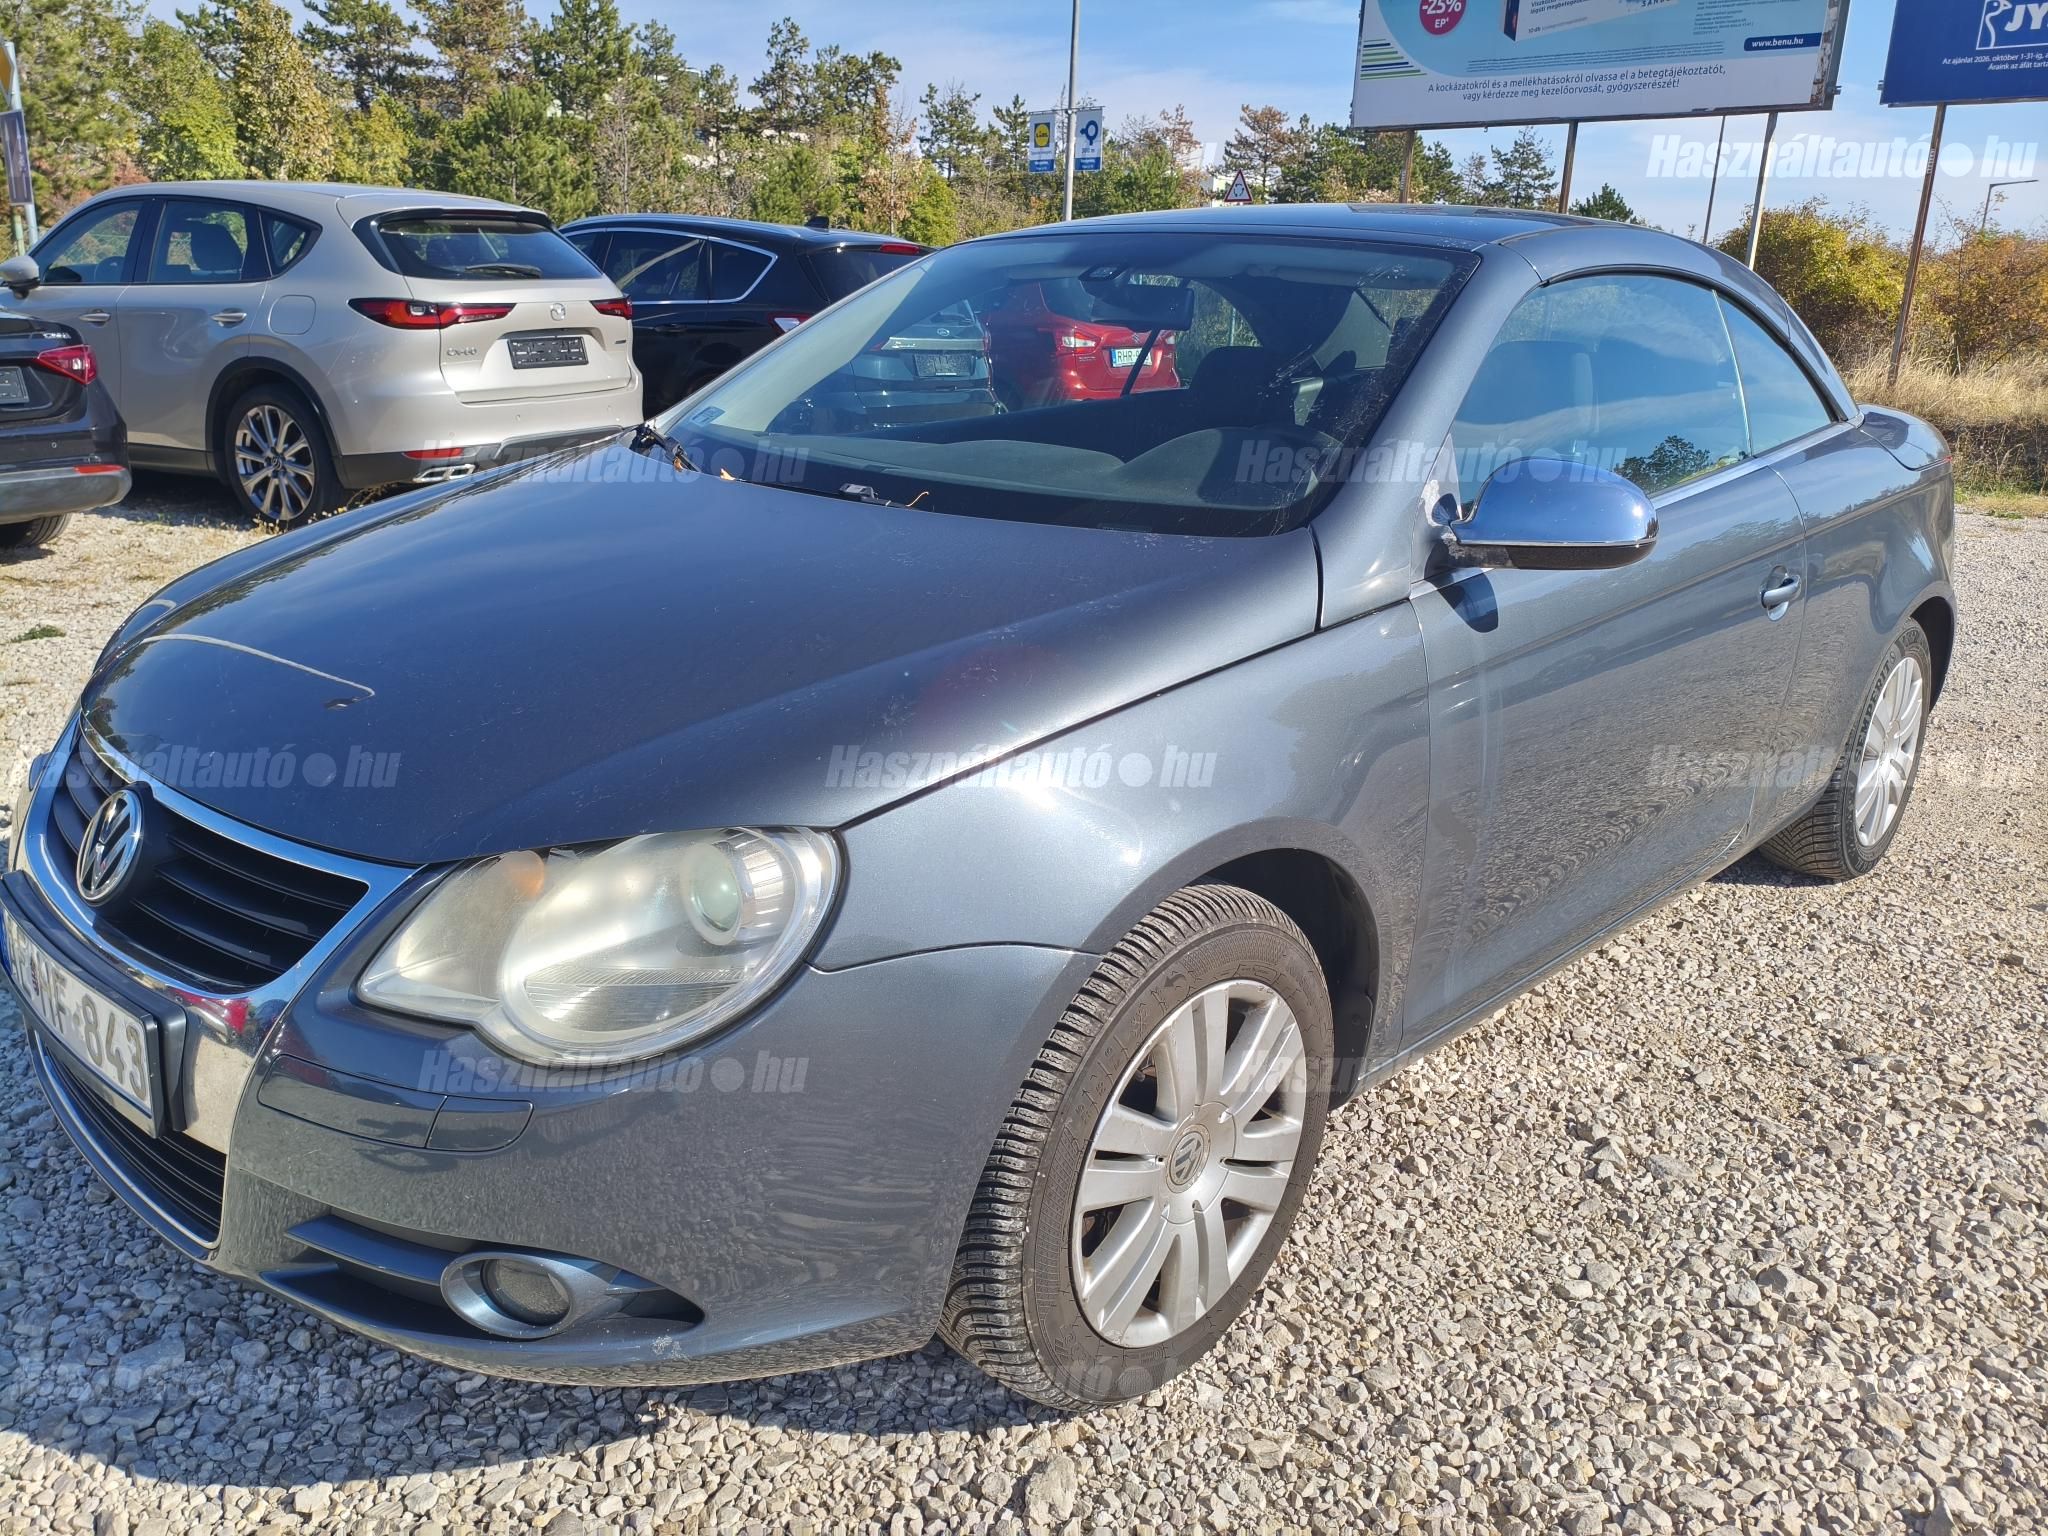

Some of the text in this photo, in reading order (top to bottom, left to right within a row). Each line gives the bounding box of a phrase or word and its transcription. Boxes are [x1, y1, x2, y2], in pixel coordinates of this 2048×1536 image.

[2004, 2, 2048, 32] JY
[1751, 37, 1805, 48] www.benu.hu
[1428, 84, 1434, 93] A
[1436, 80, 1490, 92] kockázatokról
[1492, 80, 1501, 89] és
[1510, 73, 1583, 87] mellékhatásokról
[1585, 72, 1618, 83] olvassa
[1620, 69, 1628, 80] el
[1638, 63, 1726, 80] betegtájékoztatót,
[1463, 92, 1481, 102] vagy
[1483, 89, 1519, 99] kérdezze
[1521, 88, 1539, 98] meg
[1606, 79, 1680, 94] gyógyszerészét!
[1117, 348, 1150, 363] RHR-9
